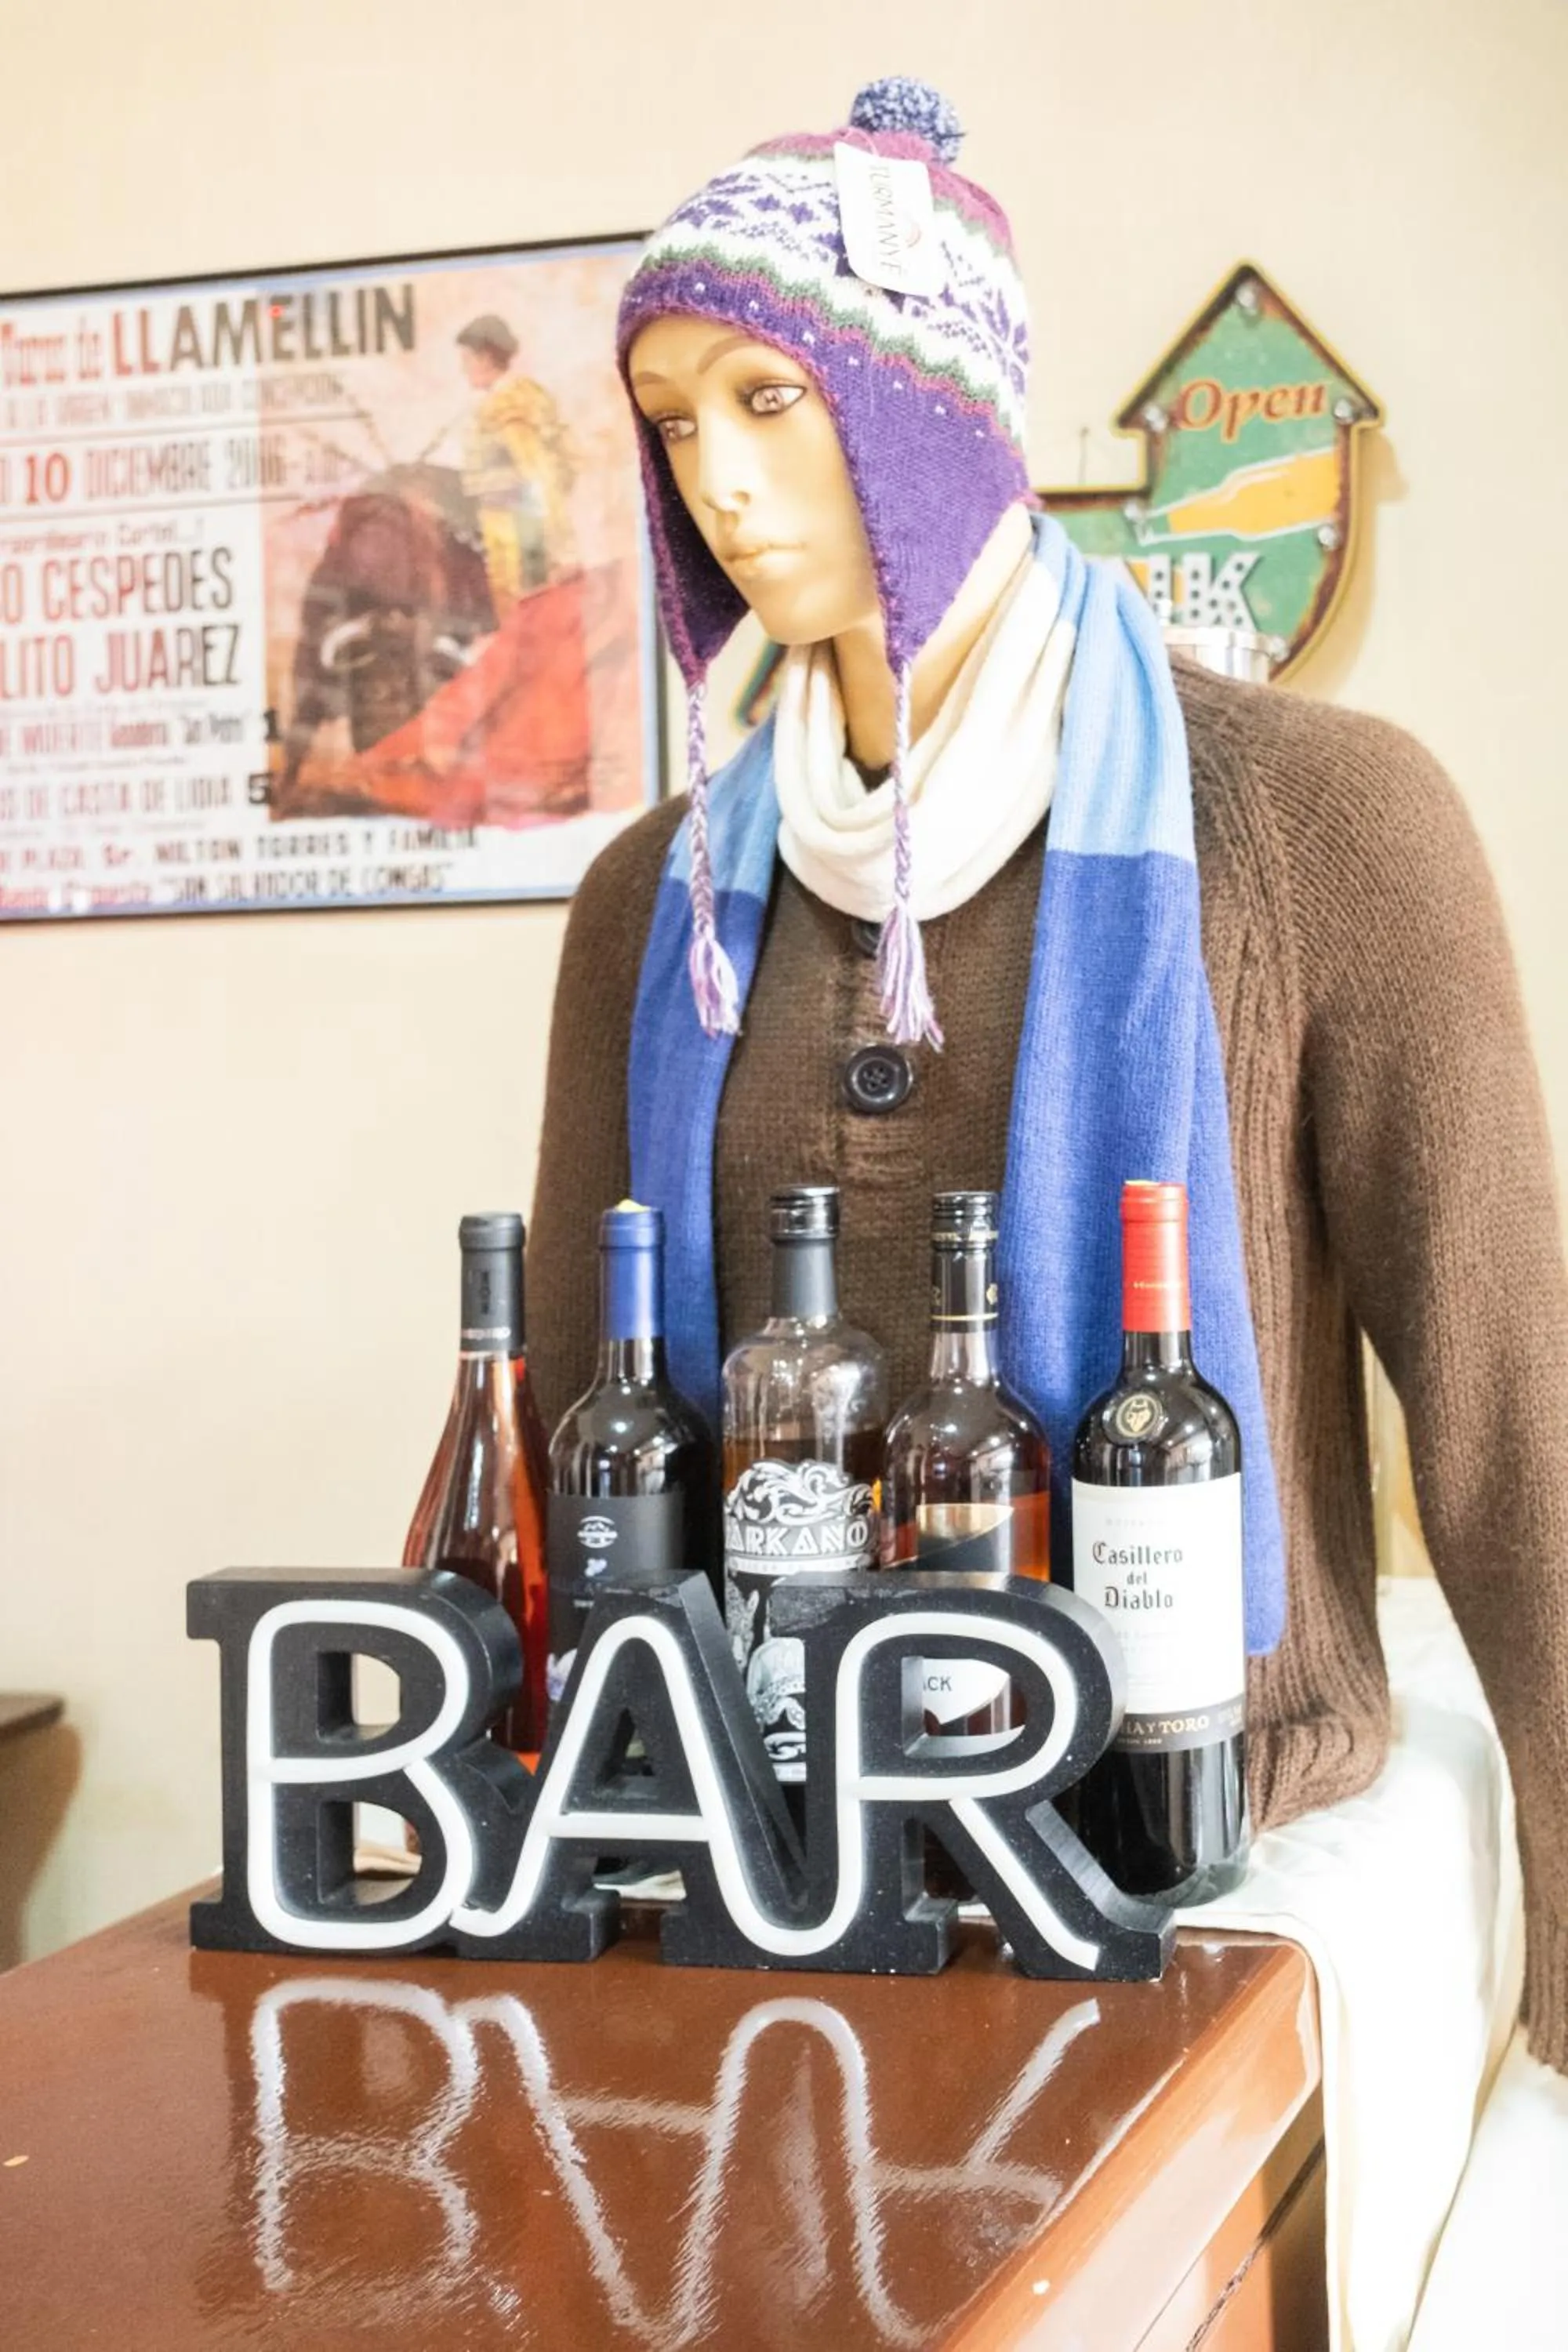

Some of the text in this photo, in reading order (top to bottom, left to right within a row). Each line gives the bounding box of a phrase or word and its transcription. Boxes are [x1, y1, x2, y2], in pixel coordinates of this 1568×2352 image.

[112, 283, 416, 376] LLAMELLIN
[1180, 379, 1329, 441] Open
[25, 452, 70, 505] 10
[85, 441, 211, 500] DICIEMBRE
[42, 547, 232, 621] CESPEDES
[95, 623, 241, 694] JUAREZ
[248, 773, 276, 804] 5
[724, 1515, 868, 1555] ARKANO
[1091, 1540, 1184, 1565] Casillero
[1104, 1585, 1174, 1610] Diablo
[1126, 1570, 1148, 1585] del
[924, 1675, 953, 1692] CK
[1158, 1715, 1210, 1735] TORO
[187, 1567, 1174, 1981] BAR
